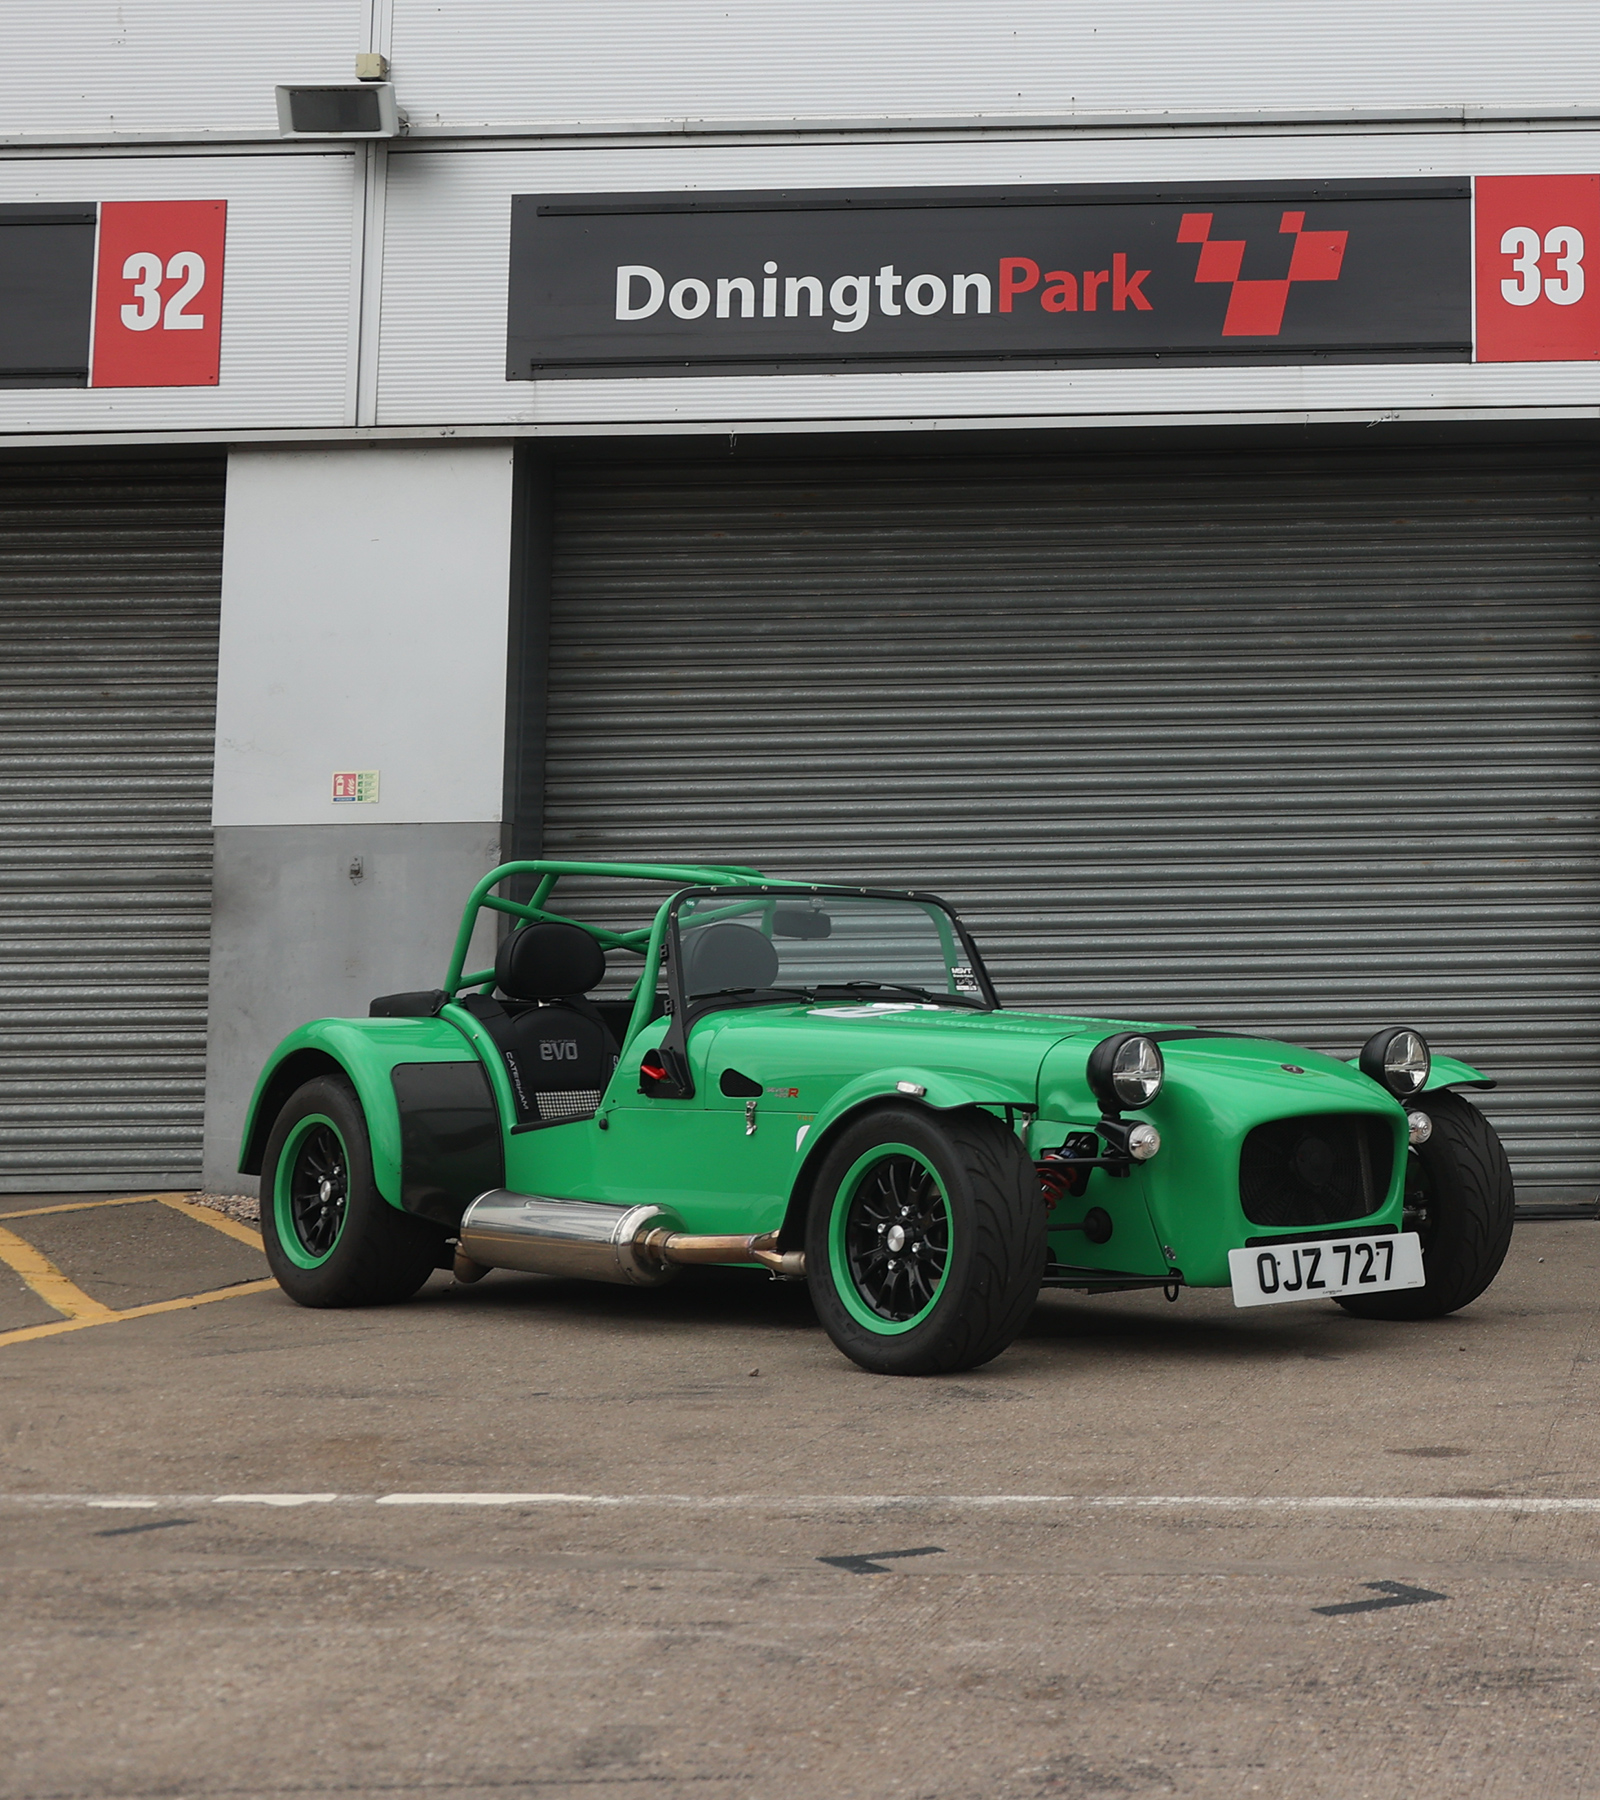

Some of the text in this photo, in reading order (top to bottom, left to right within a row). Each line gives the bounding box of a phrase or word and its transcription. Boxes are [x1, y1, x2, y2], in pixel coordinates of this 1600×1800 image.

[120, 250, 206, 332] 32
[1500, 226, 1585, 306] 33
[505, 1051, 529, 1110] CATERHAM
[540, 1042, 578, 1060] evo
[1331, 1240, 1394, 1287] 727
